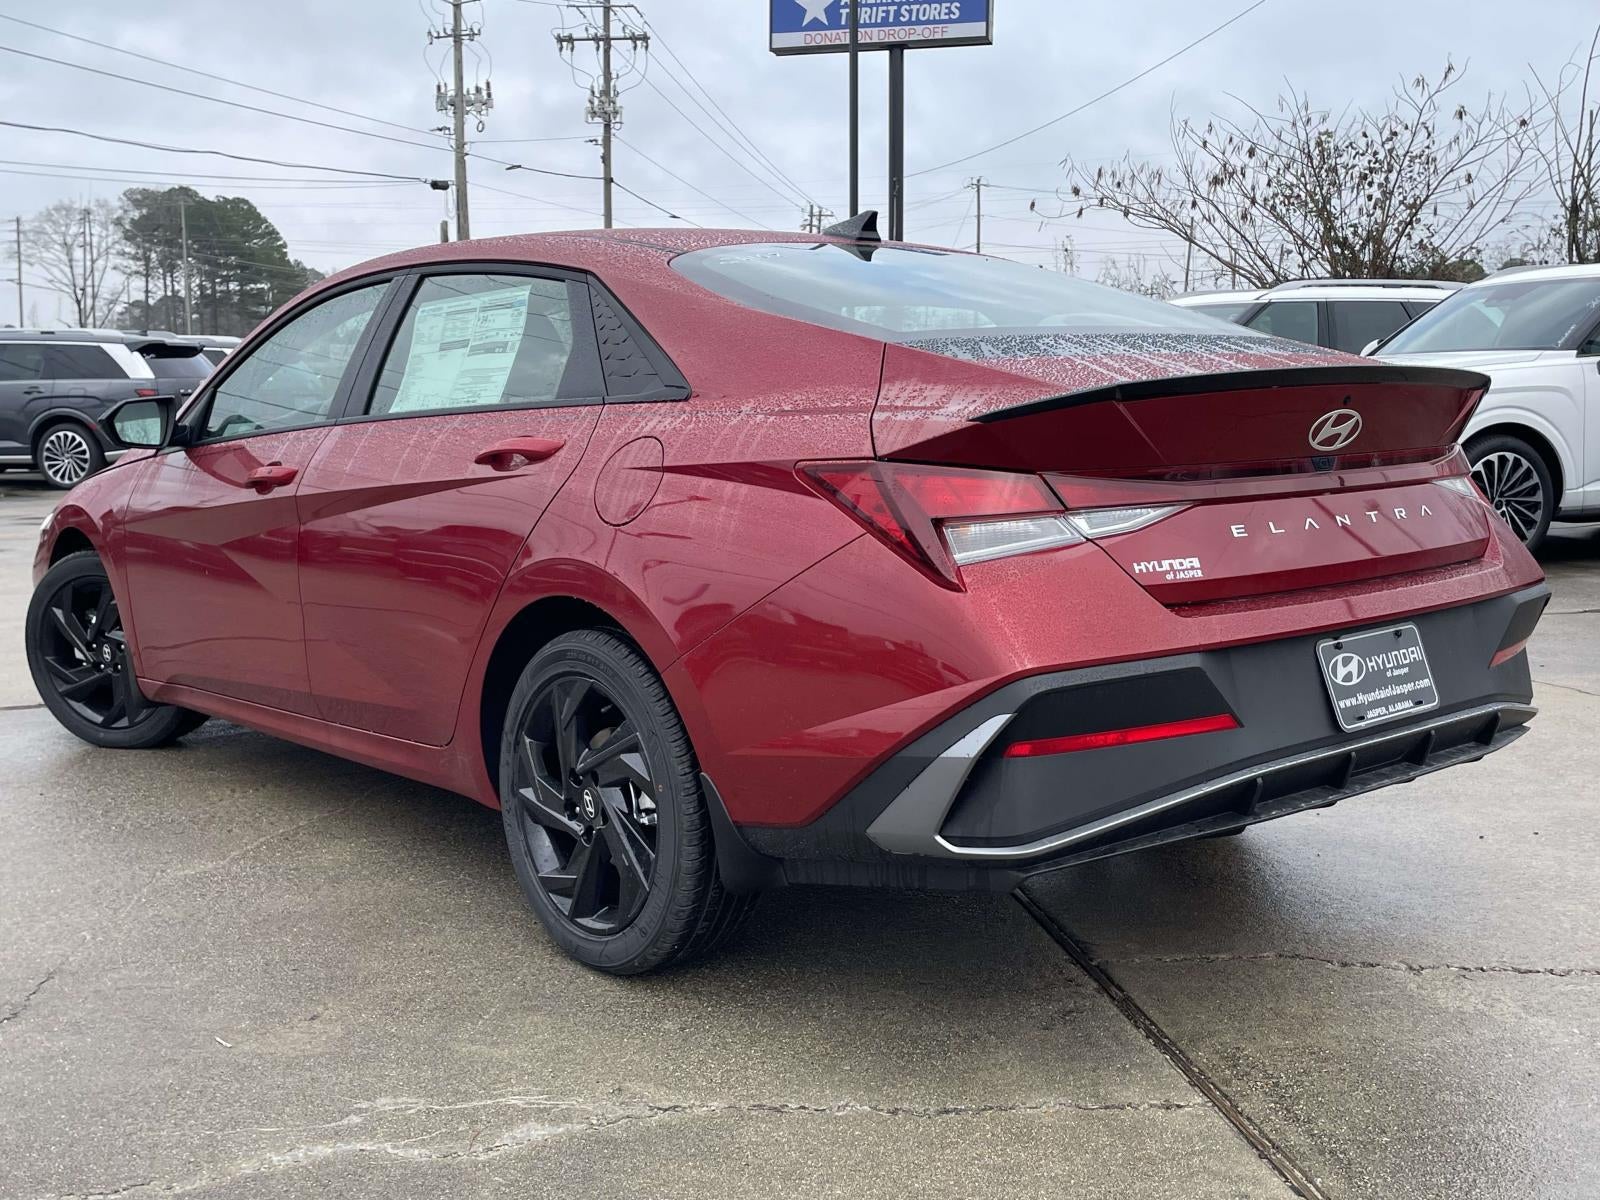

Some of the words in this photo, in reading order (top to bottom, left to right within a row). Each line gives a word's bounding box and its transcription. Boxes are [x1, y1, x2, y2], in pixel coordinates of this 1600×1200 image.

[840, 6, 897, 24] TRIFT
[899, 1, 960, 22] STORES
[803, 29, 873, 45] DONATON
[877, 26, 949, 41] DROP-OFF
[1230, 504, 1433, 538] ELANTRA
[1132, 557, 1201, 574] HYUNDAI
[1165, 570, 1175, 580] of
[1176, 570, 1203, 579] JASPER
[1366, 646, 1422, 672] HYUNDAI
[1338, 678, 1430, 708] www.HyundaiofJasper.com
[1367, 707, 1388, 718] JASPER,
[1388, 700, 1413, 712] ALABAMA
